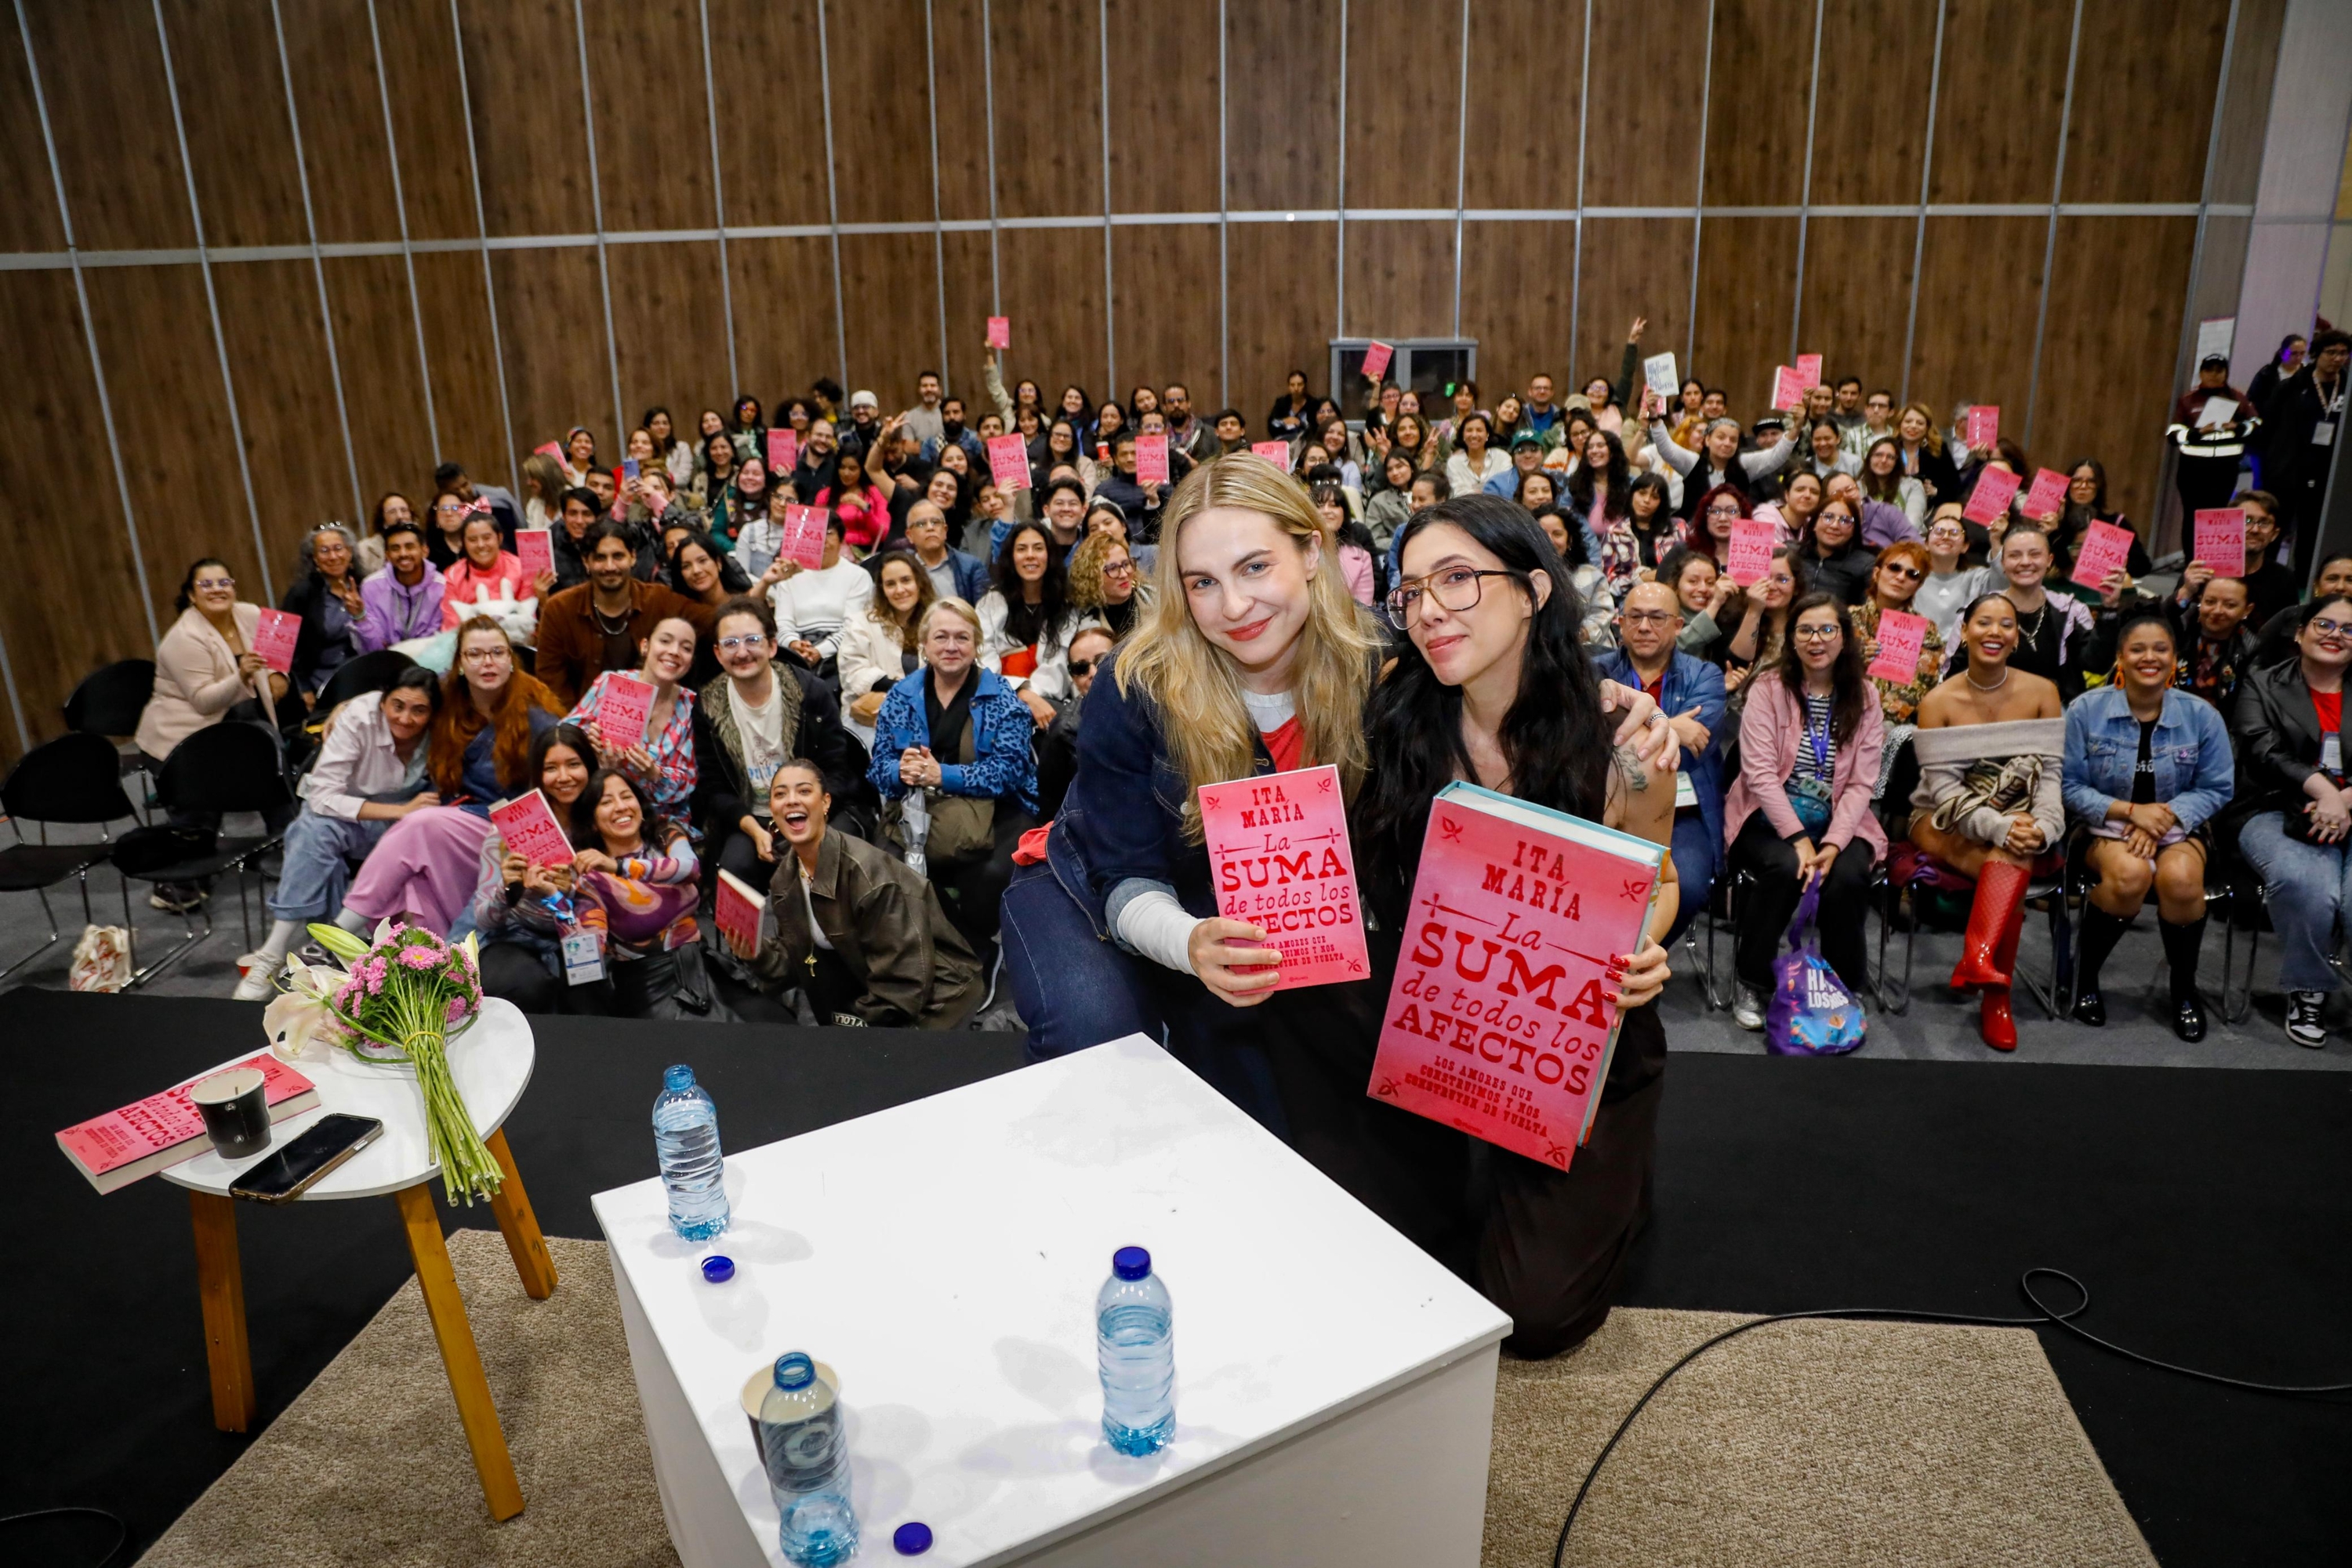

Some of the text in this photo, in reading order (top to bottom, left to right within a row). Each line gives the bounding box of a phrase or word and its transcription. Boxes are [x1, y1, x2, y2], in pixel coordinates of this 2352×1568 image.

[1731, 543, 1770, 556] SUMA
[2085, 543, 2122, 564] SUMA
[2197, 534, 2241, 546] SUMA
[1729, 561, 1769, 571] AFECTOS
[1879, 633, 1918, 652] SUMA
[602, 700, 644, 721] SUMA
[599, 720, 641, 738] AFECTOS
[1252, 786, 1285, 805] ITA
[1241, 799, 1304, 829] MARÍA
[507, 819, 554, 848] SUMA
[1264, 833, 1290, 853] La
[525, 837, 563, 861] FECTOS
[1512, 840, 1564, 881] ITA
[1221, 847, 1347, 892] SUMA
[1225, 883, 1350, 915] de todos los
[1482, 863, 1580, 921] MARÍA
[1233, 903, 1353, 934] FECTOS
[1497, 912, 1541, 950] La
[1279, 938, 1309, 949] AMORES
[1312, 935, 1326, 944] QUE
[1320, 944, 1335, 953] NOS
[1302, 956, 1311, 965] DE
[1315, 953, 1345, 964] VUELTA
[1411, 922, 1607, 1029] SUMA
[1401, 971, 1600, 1062] de todos los
[1392, 1004, 1590, 1095] AFECTOS
[1420, 1065, 1541, 1119] CONSTRUIMOS Y NOS
[1434, 1055, 1533, 1102] LOS AMORES QUE
[1405, 1073, 1548, 1138] CONSTRUYEN DE VUELTA
[118, 1105, 176, 1146] AFECTOS
